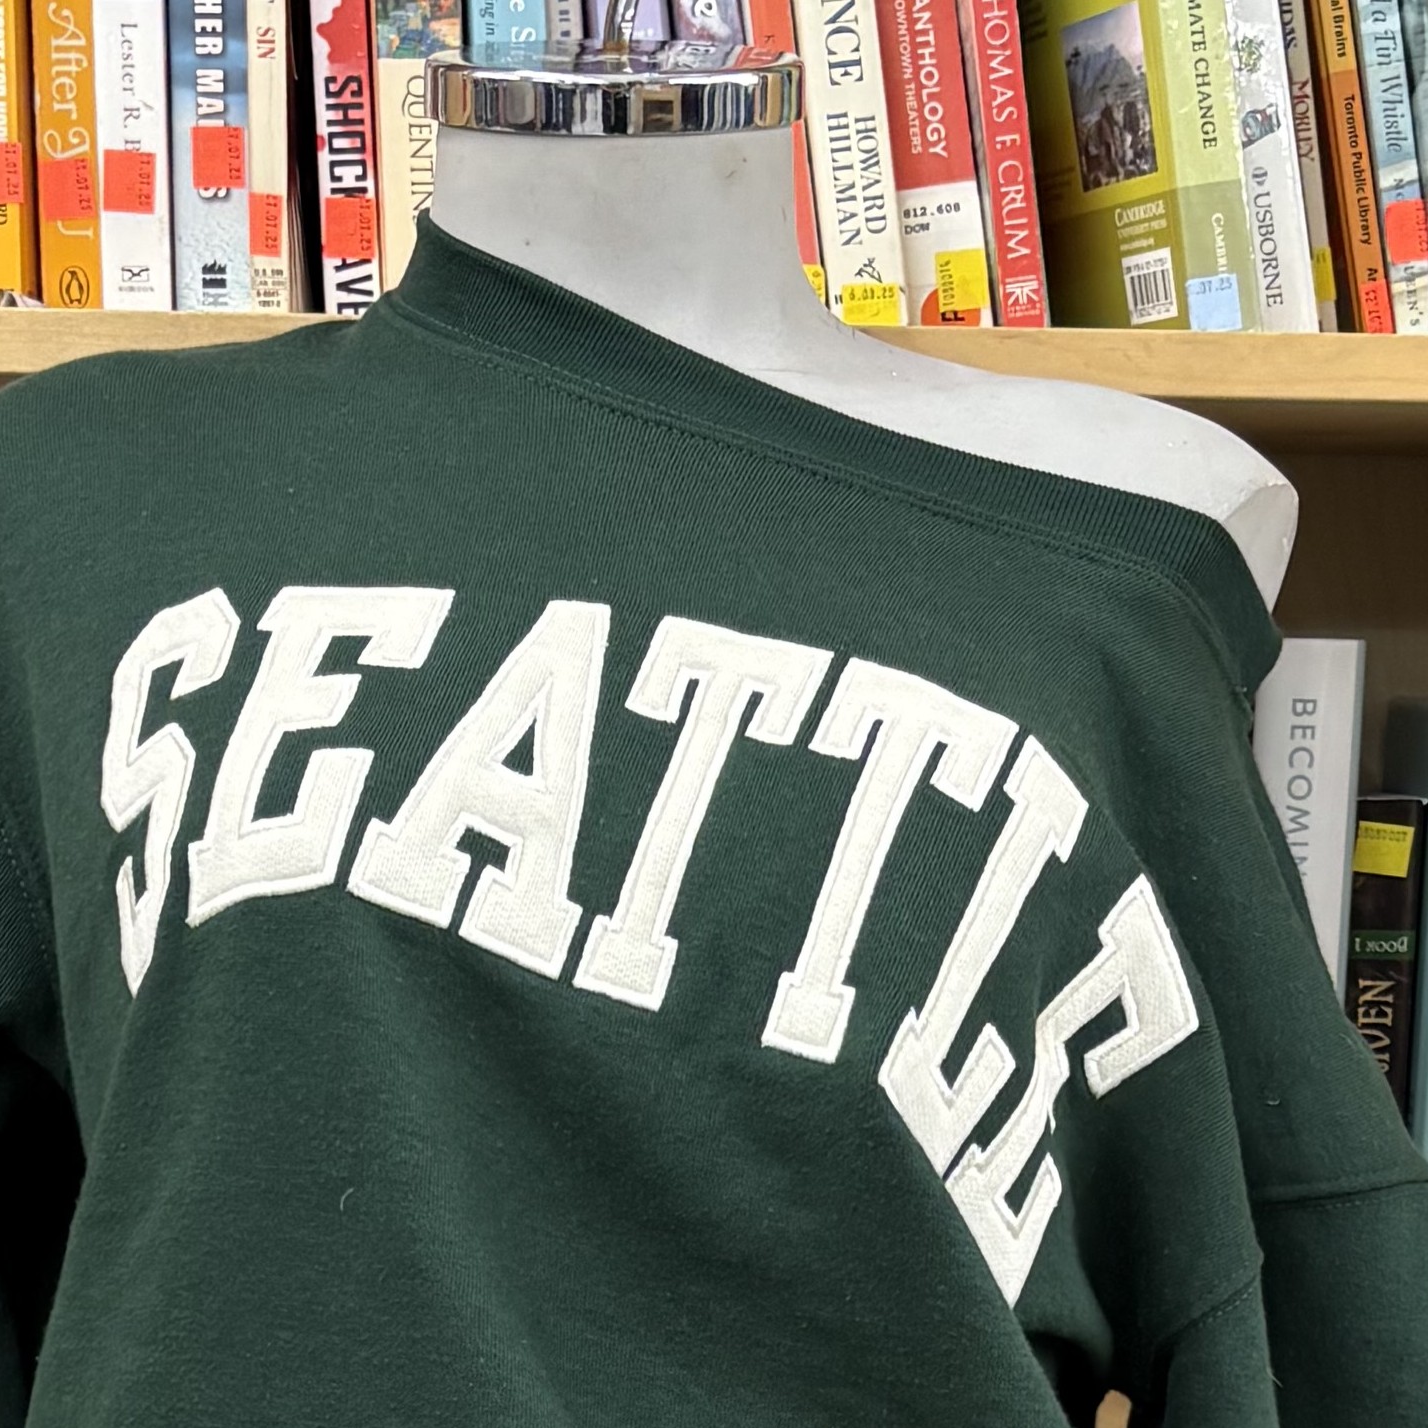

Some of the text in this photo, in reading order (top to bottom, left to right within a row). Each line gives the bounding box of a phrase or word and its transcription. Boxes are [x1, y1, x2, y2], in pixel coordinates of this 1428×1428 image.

[899, 60, 921, 156] THEATERS
[1188, 63, 1217, 149] CHANGE
[826, 112, 862, 248] HILLMAN
[854, 115, 886, 234] HOWARD
[1343, 94, 1371, 246] Toronto Public Library
[1253, 192, 1283, 307] USBORNE
[100, 584, 1200, 1308] SEATTLE
